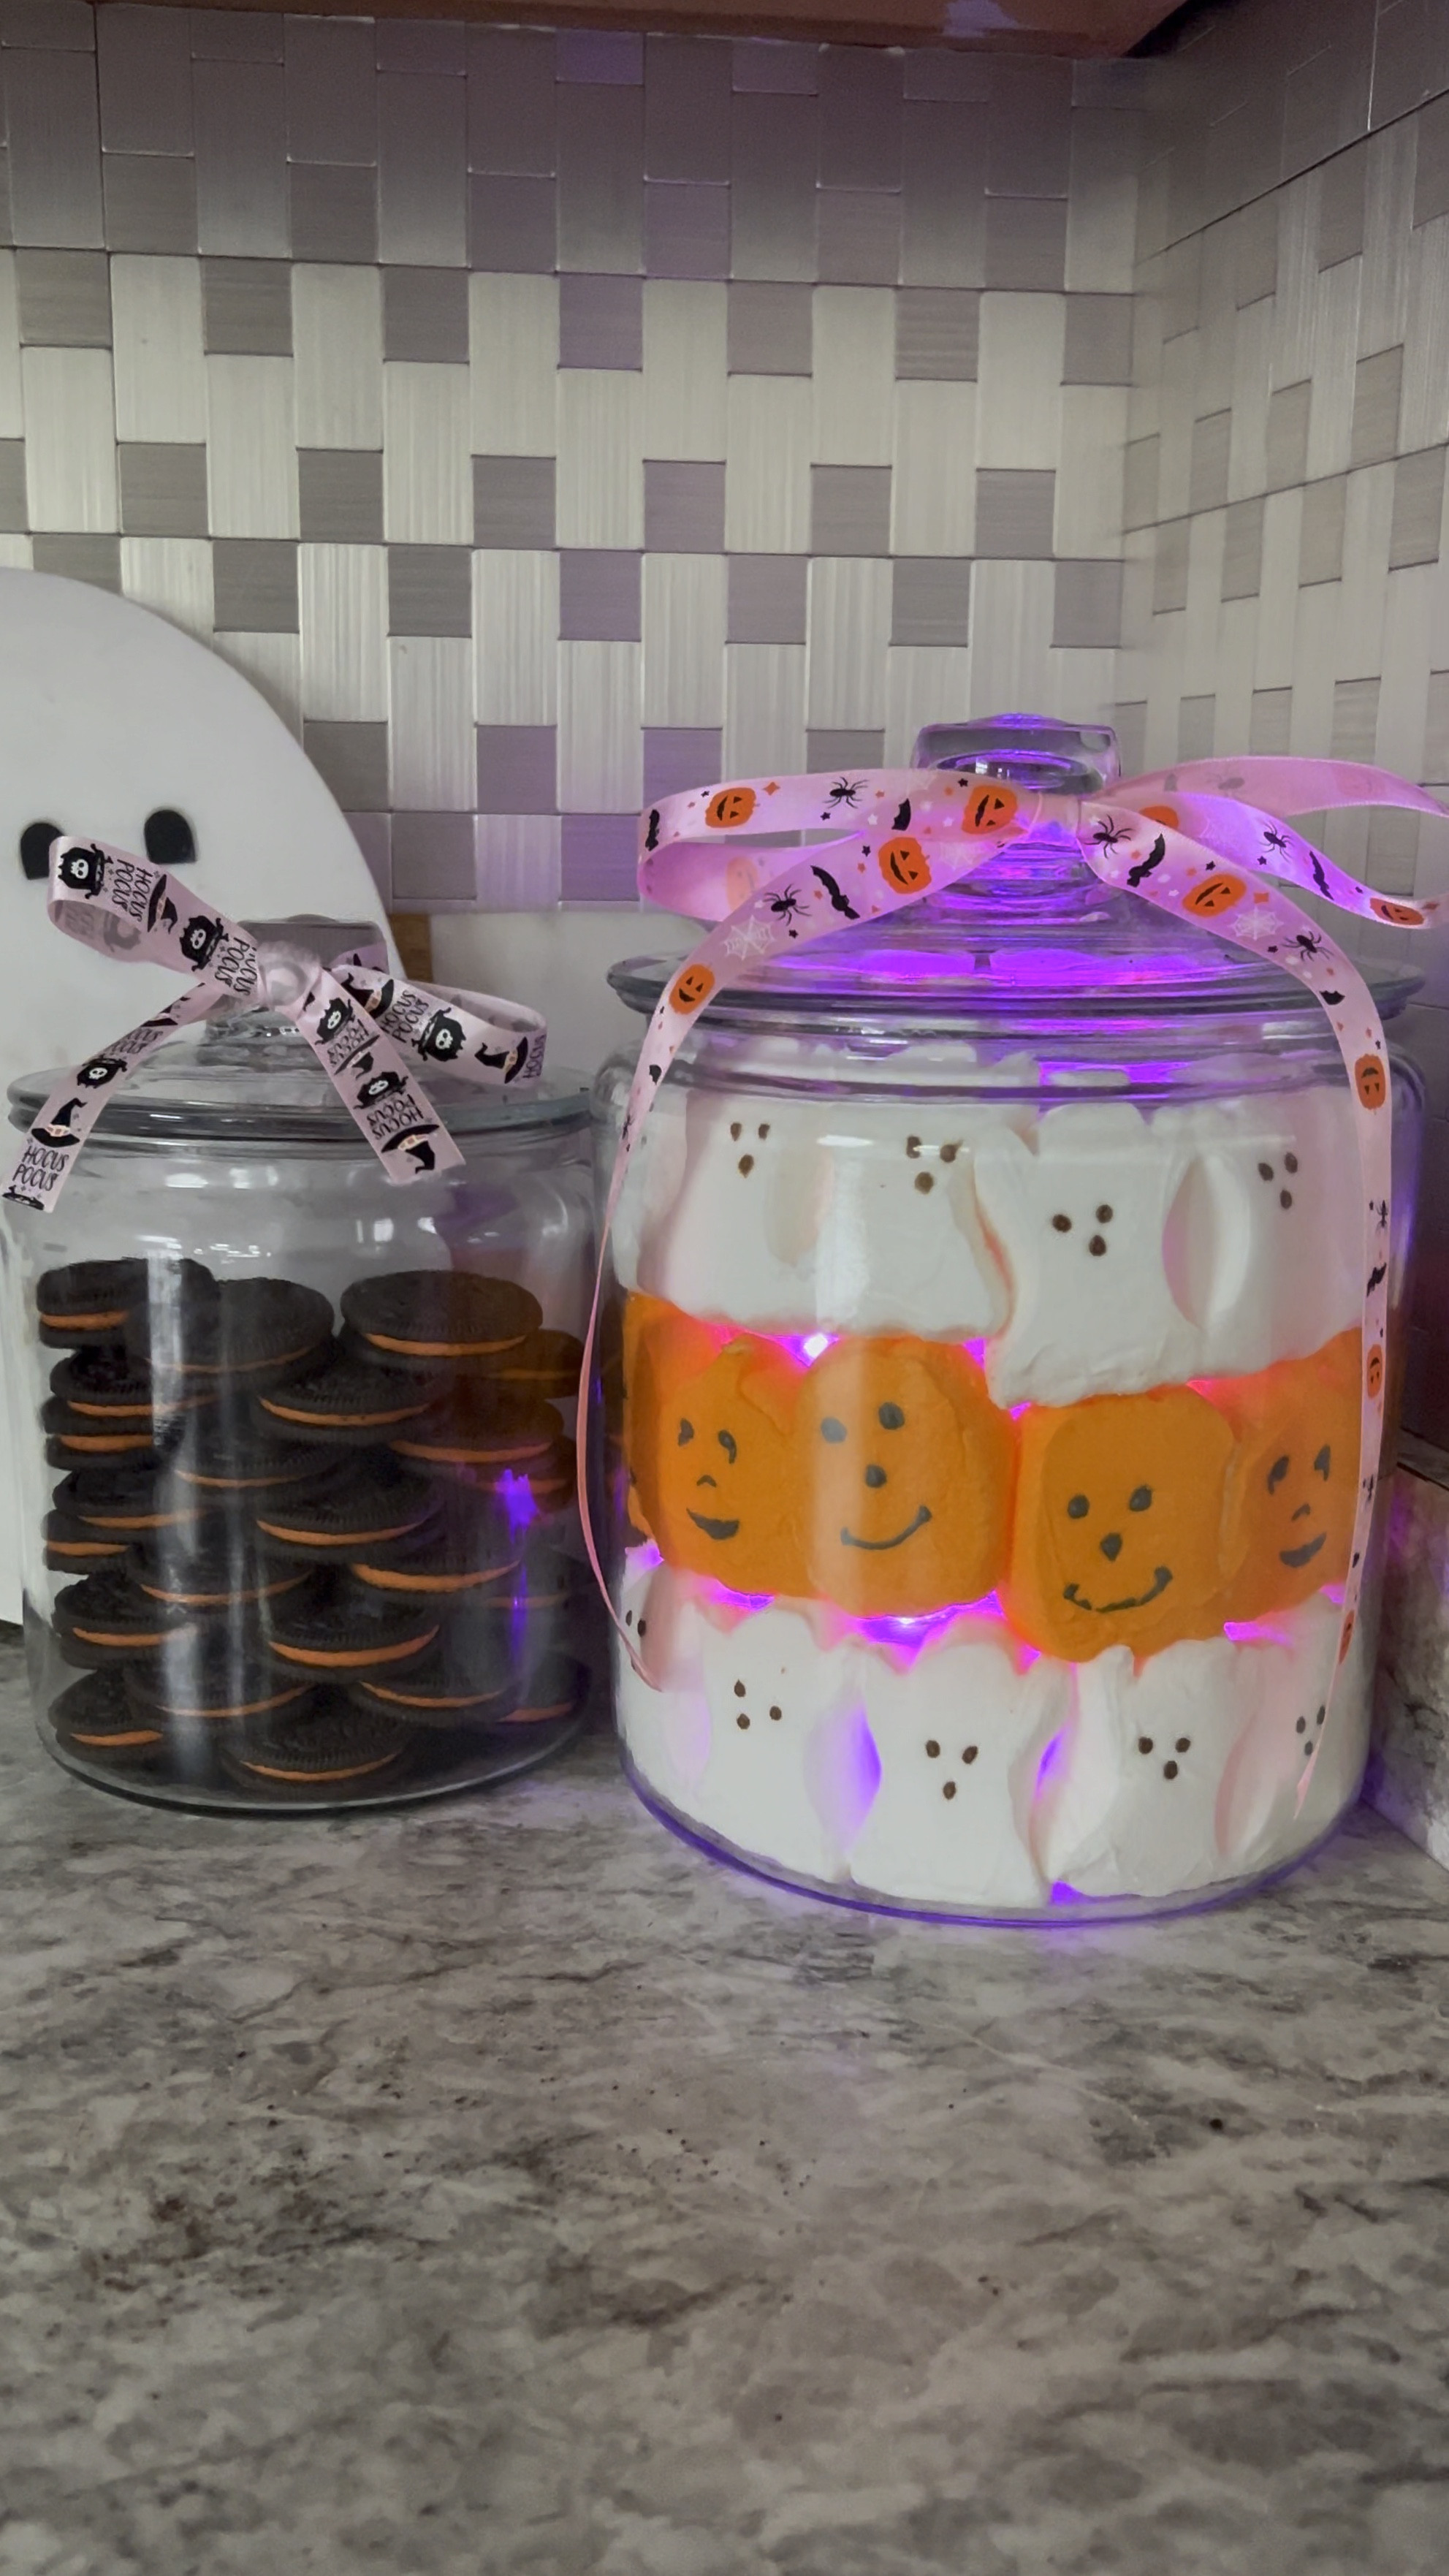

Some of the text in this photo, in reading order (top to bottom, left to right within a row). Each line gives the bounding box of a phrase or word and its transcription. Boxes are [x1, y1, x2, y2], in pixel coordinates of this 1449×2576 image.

[112, 859, 134, 912] POCUS
[129, 867, 153, 922] HOCUS
[215, 937, 250, 987] POCUS
[380, 989, 417, 1034] HOCUS
[392, 998, 429, 1044] POCUS
[366, 1093, 415, 1128] POCUS
[371, 1106, 424, 1140] HOCUS
[12, 1163, 58, 1191] POCUS
[21, 1145, 69, 1172] HOCUS
